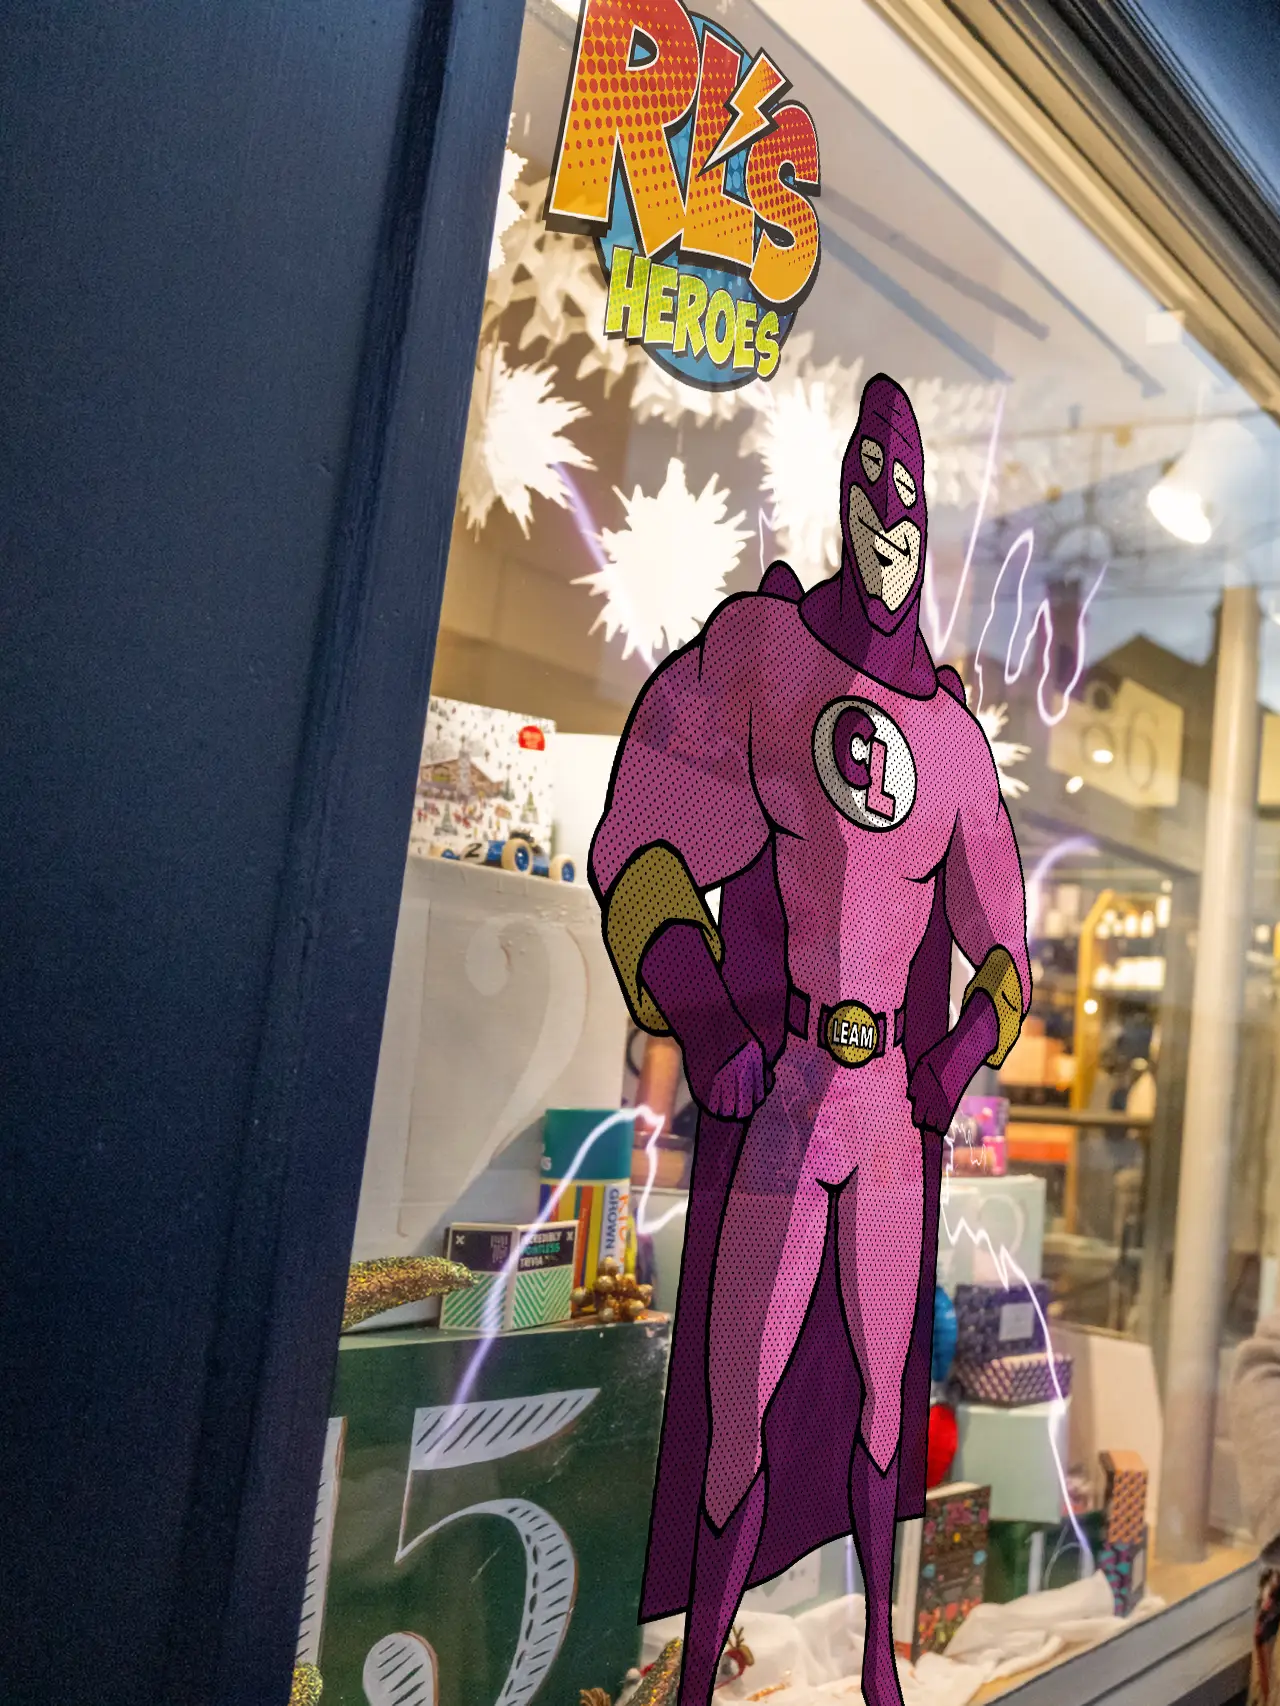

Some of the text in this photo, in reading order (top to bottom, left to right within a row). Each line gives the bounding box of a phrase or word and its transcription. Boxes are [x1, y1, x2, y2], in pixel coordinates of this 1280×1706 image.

[546, 0, 821, 308] RLS
[604, 246, 780, 377] HEROES
[832, 1019, 874, 1050] LEAM
[604, 1188, 621, 1249] GROWN
